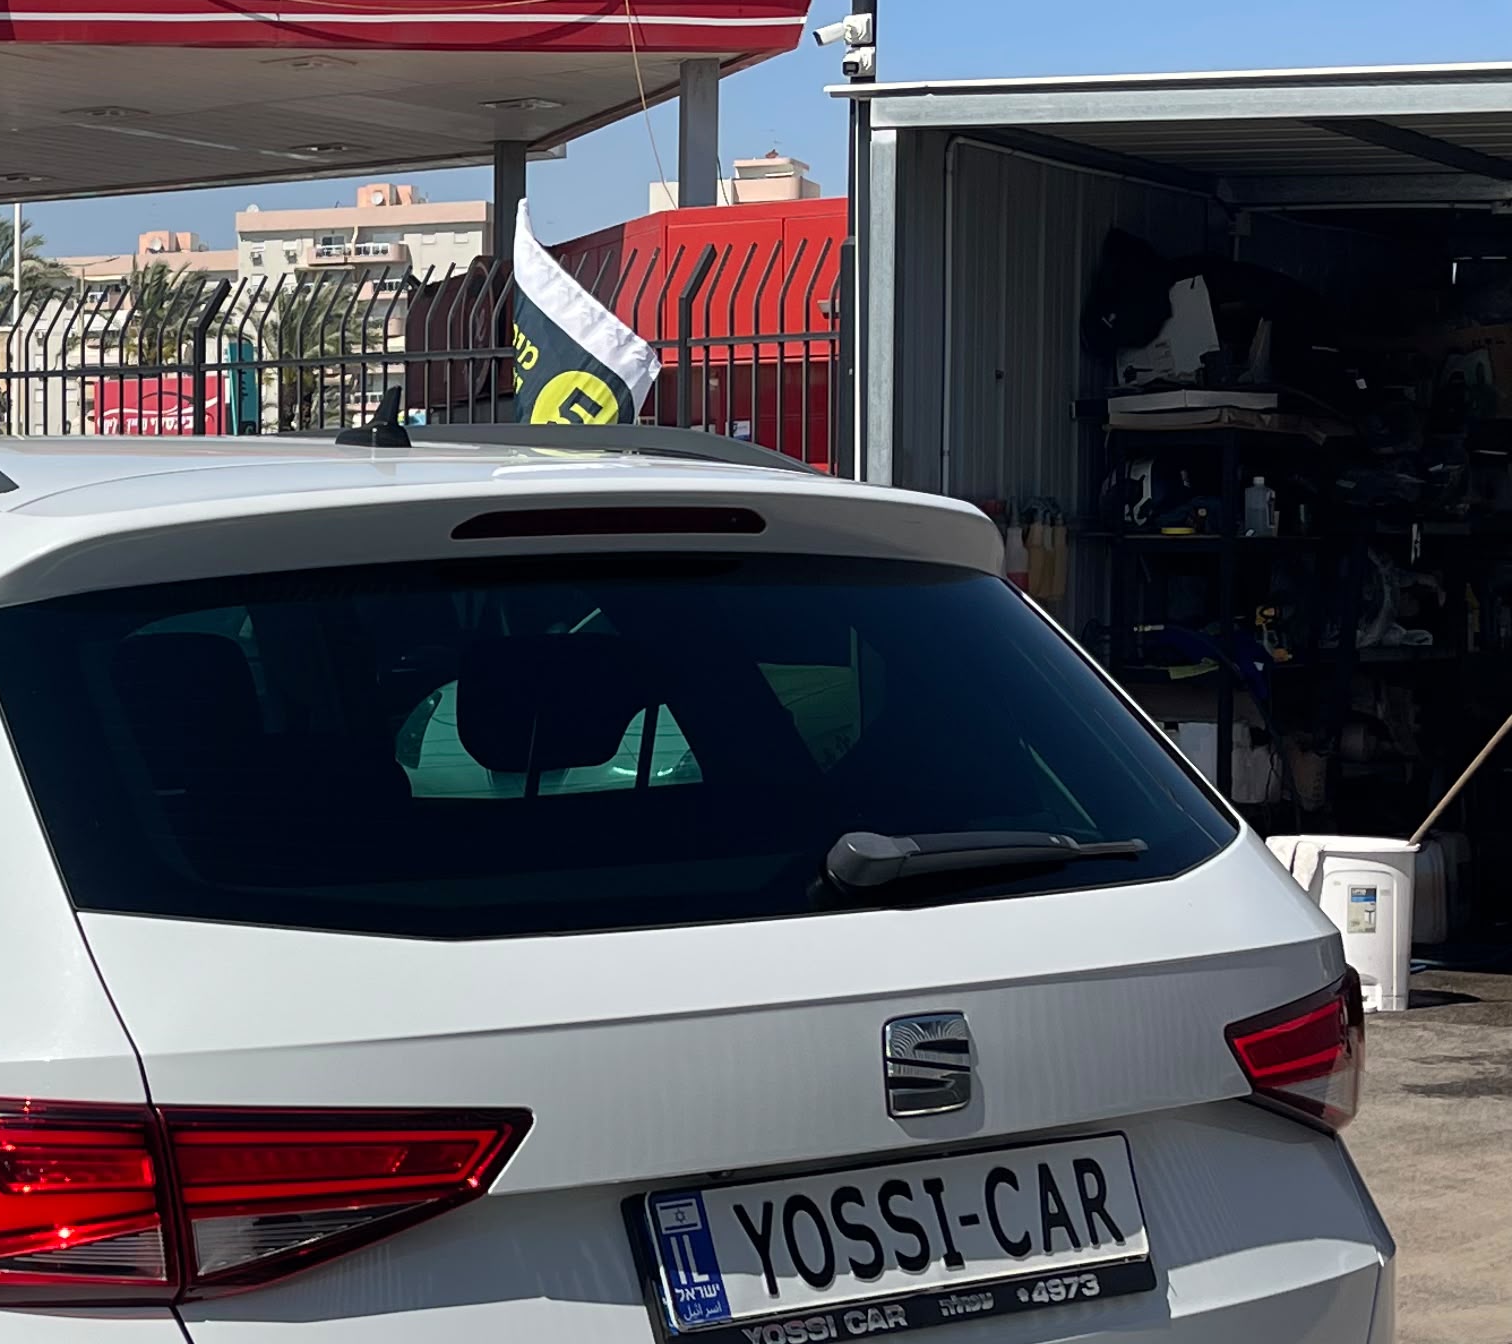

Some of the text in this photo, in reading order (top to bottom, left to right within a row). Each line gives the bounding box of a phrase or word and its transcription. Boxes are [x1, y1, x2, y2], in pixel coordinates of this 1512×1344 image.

[733, 1157, 1127, 1299] YOSSI-CAR
[670, 1234, 710, 1285] IL
[674, 1283, 721, 1303] ישראל
[843, 1304, 909, 1335] CAR
